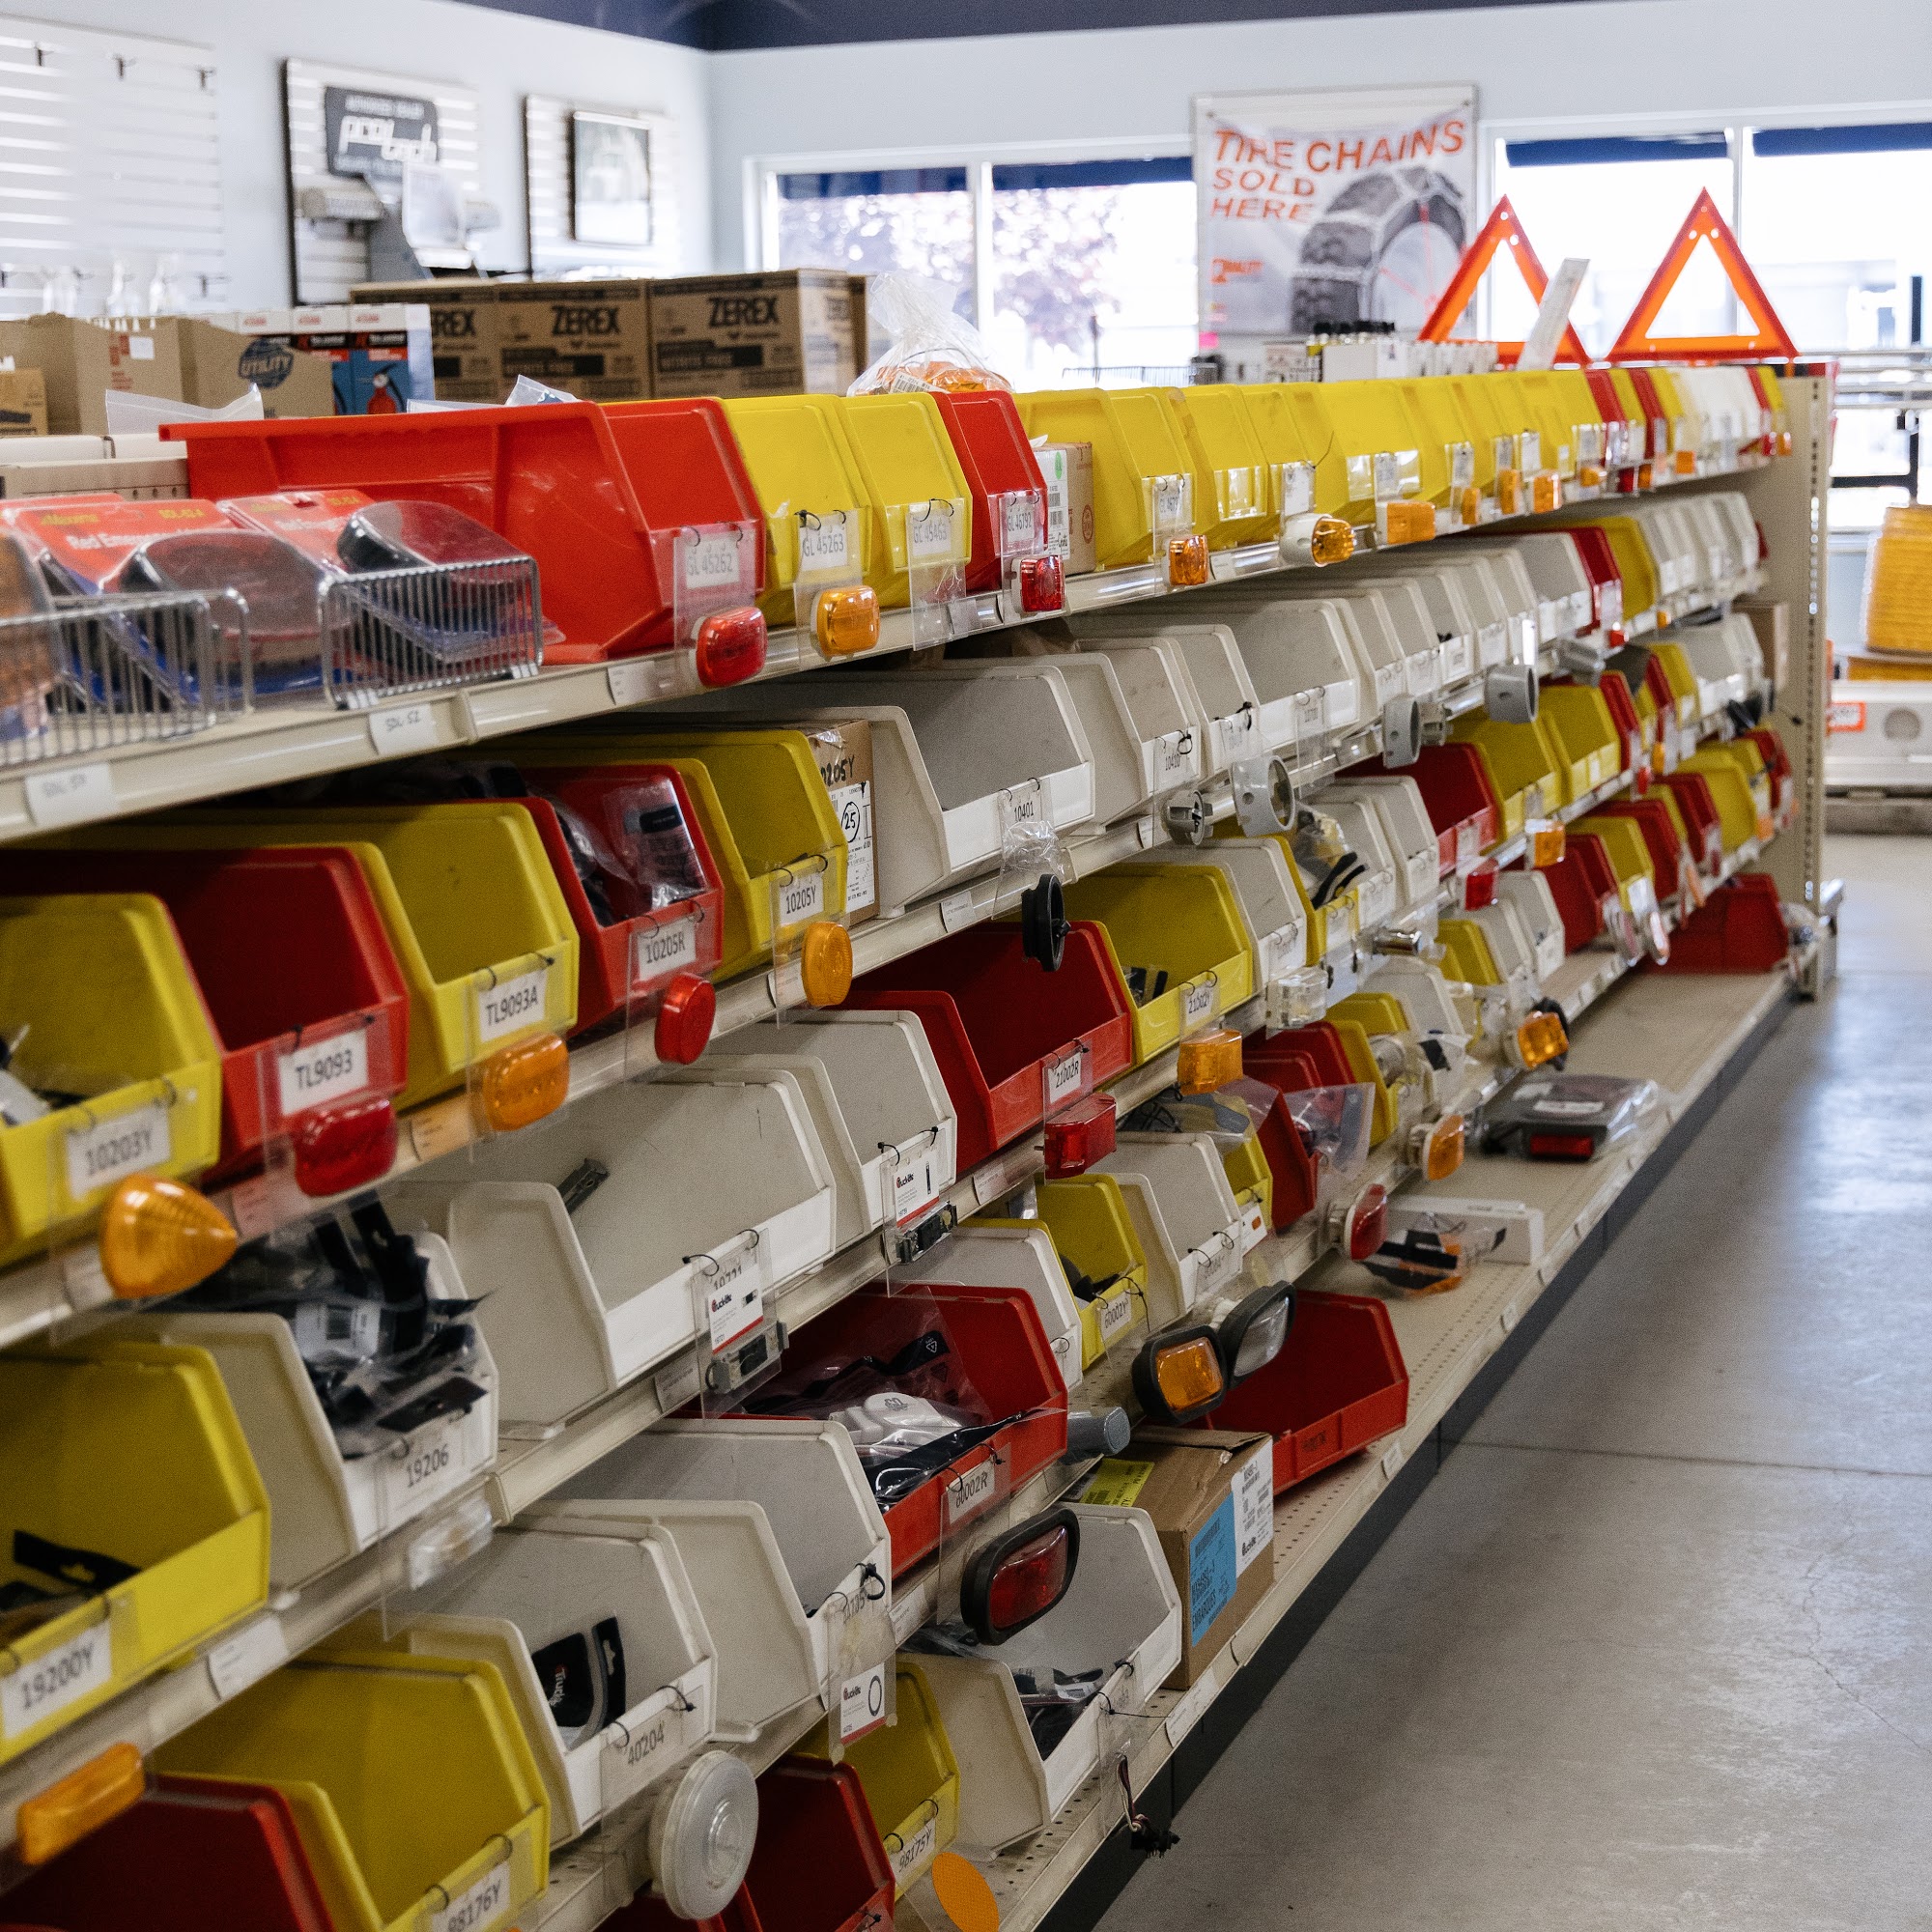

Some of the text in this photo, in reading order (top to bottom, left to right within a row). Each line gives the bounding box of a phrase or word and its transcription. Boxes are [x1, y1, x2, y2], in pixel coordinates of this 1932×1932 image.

[1213, 120, 1465, 172] TIRE CHAINS
[1211, 167, 1315, 197] SOLD
[1209, 197, 1316, 223] HERE
[552, 305, 621, 335] ZEREX
[708, 297, 779, 328] ZEREX
[1008, 516, 1015, 532] GL
[803, 533, 844, 557] GL 45263
[844, 811, 857, 831] 25
[1014, 801, 1035, 821] 10401
[785, 885, 817, 915] 10205Y
[645, 930, 687, 964] 10205R
[486, 984, 539, 1026] TL9093A
[296, 1049, 353, 1089] TL9093
[1056, 1060, 1079, 1089] 21002R
[84, 1128, 153, 1177] 10203Y
[407, 1442, 449, 1488] 19206
[21, 1641, 96, 1710] 19200Y
[628, 1721, 666, 1765] 40204
[897, 1829, 933, 1873] 98175Y
